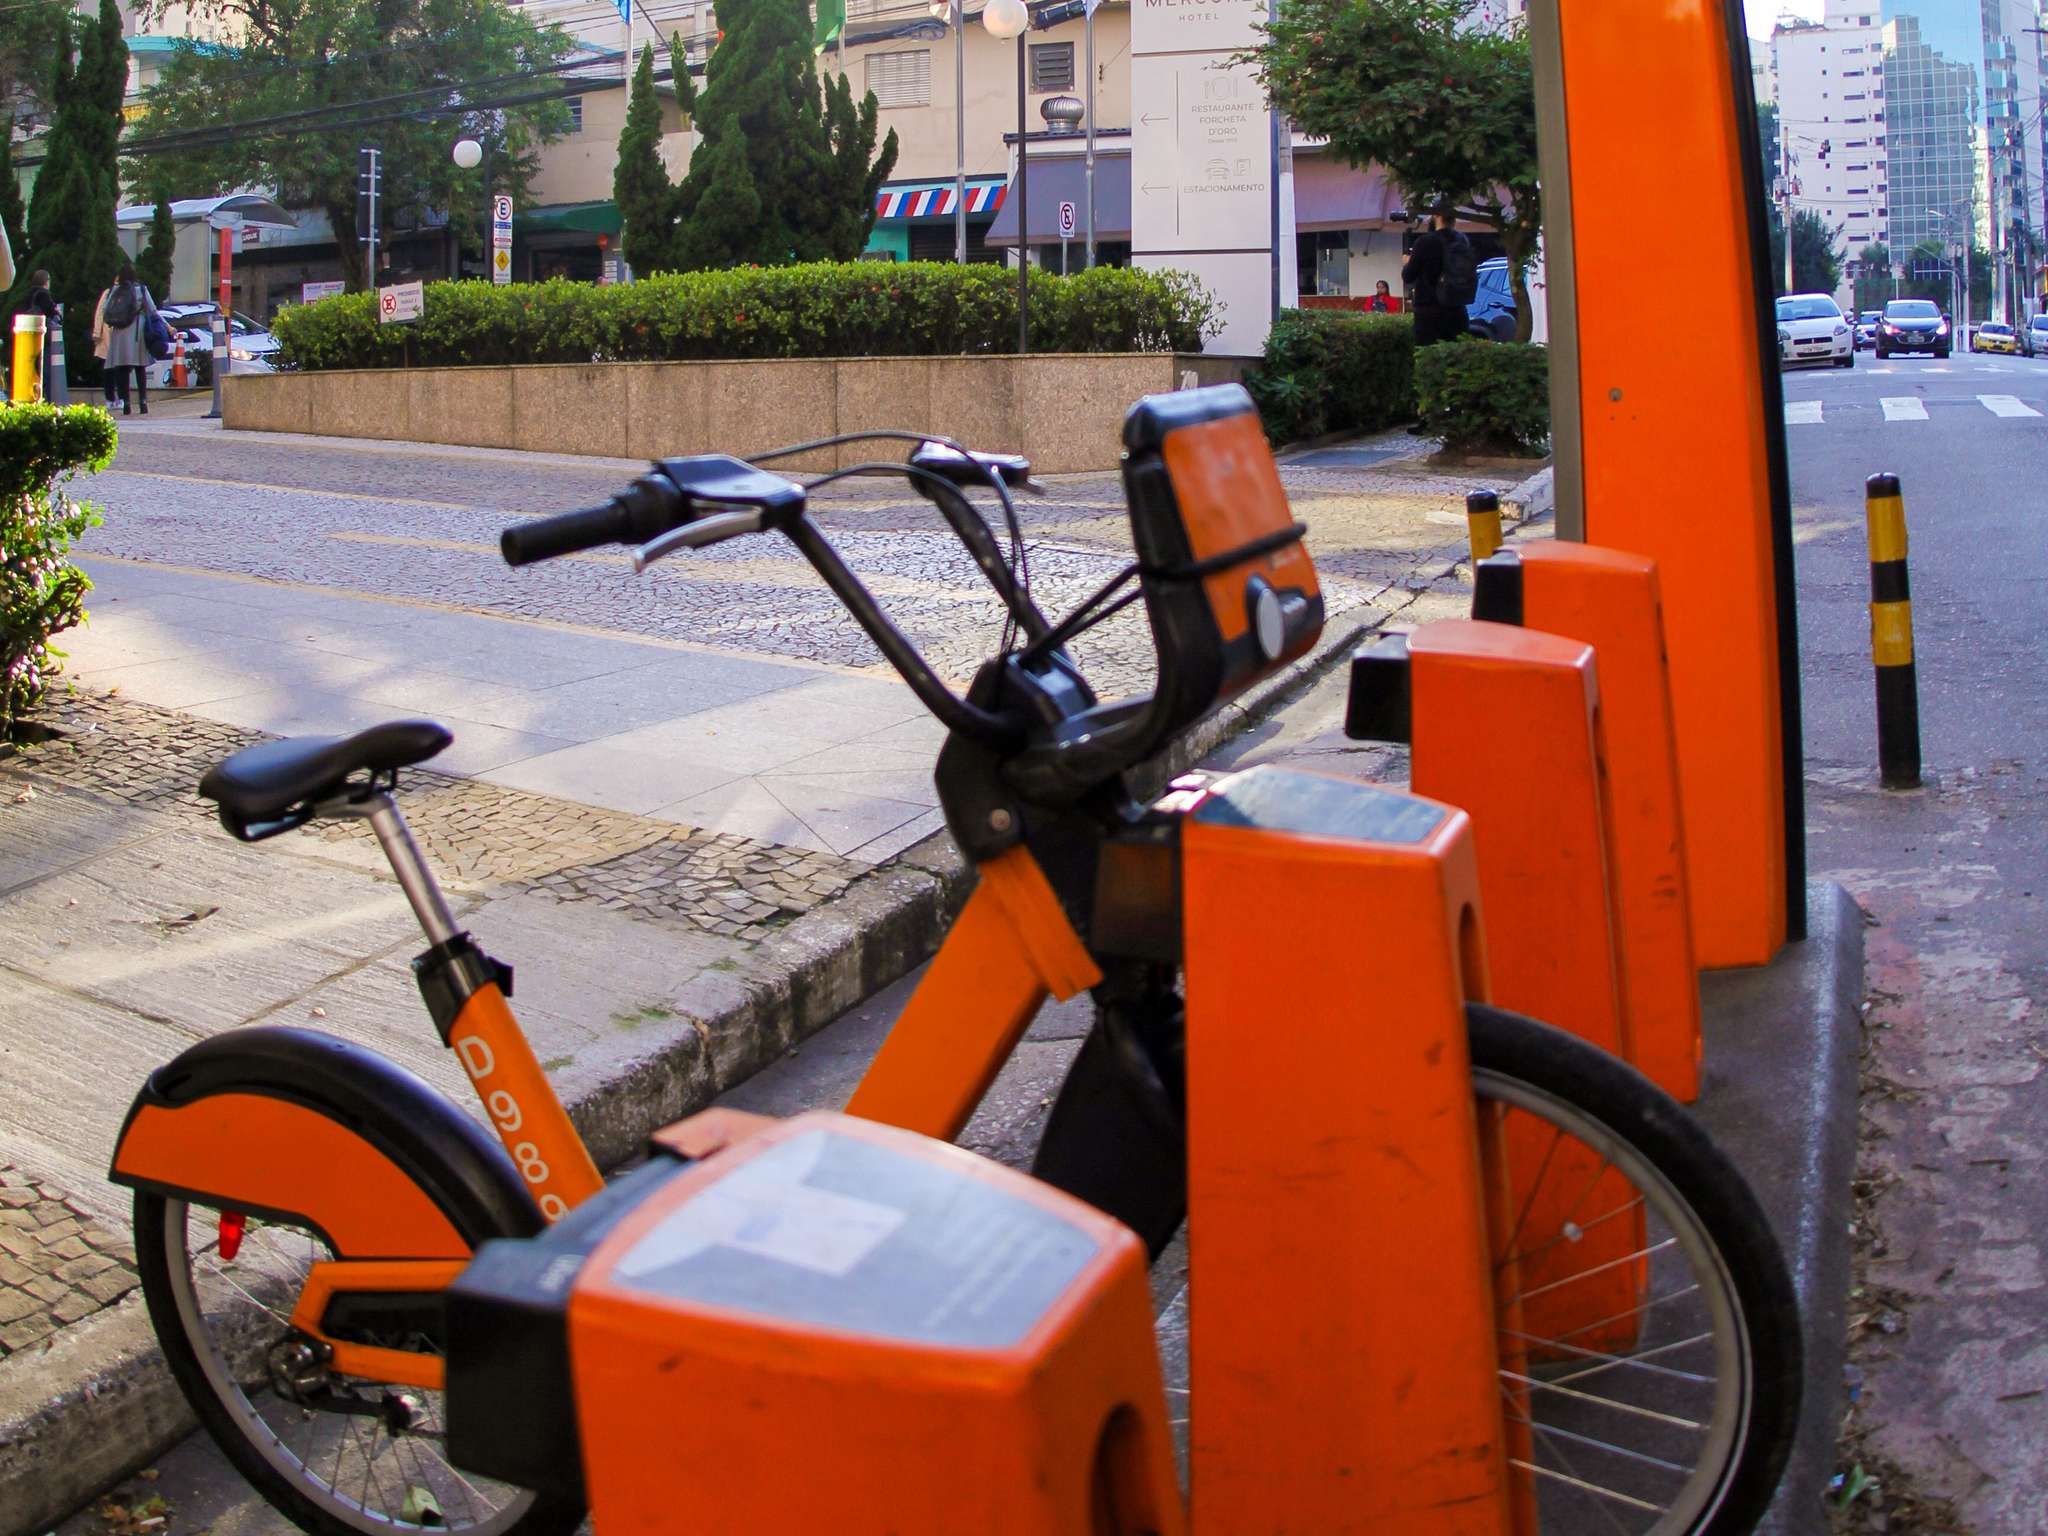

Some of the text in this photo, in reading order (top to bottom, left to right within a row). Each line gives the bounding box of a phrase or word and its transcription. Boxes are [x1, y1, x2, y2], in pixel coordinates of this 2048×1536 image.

[1178, 13, 1220, 21] HOTEL
[1191, 103, 1255, 113] RESTAURANTE
[1199, 115, 1247, 125] FORCHETA
[1208, 127, 1238, 136] D'ORO
[1183, 183, 1265, 194] ESTACIONAMENTO
